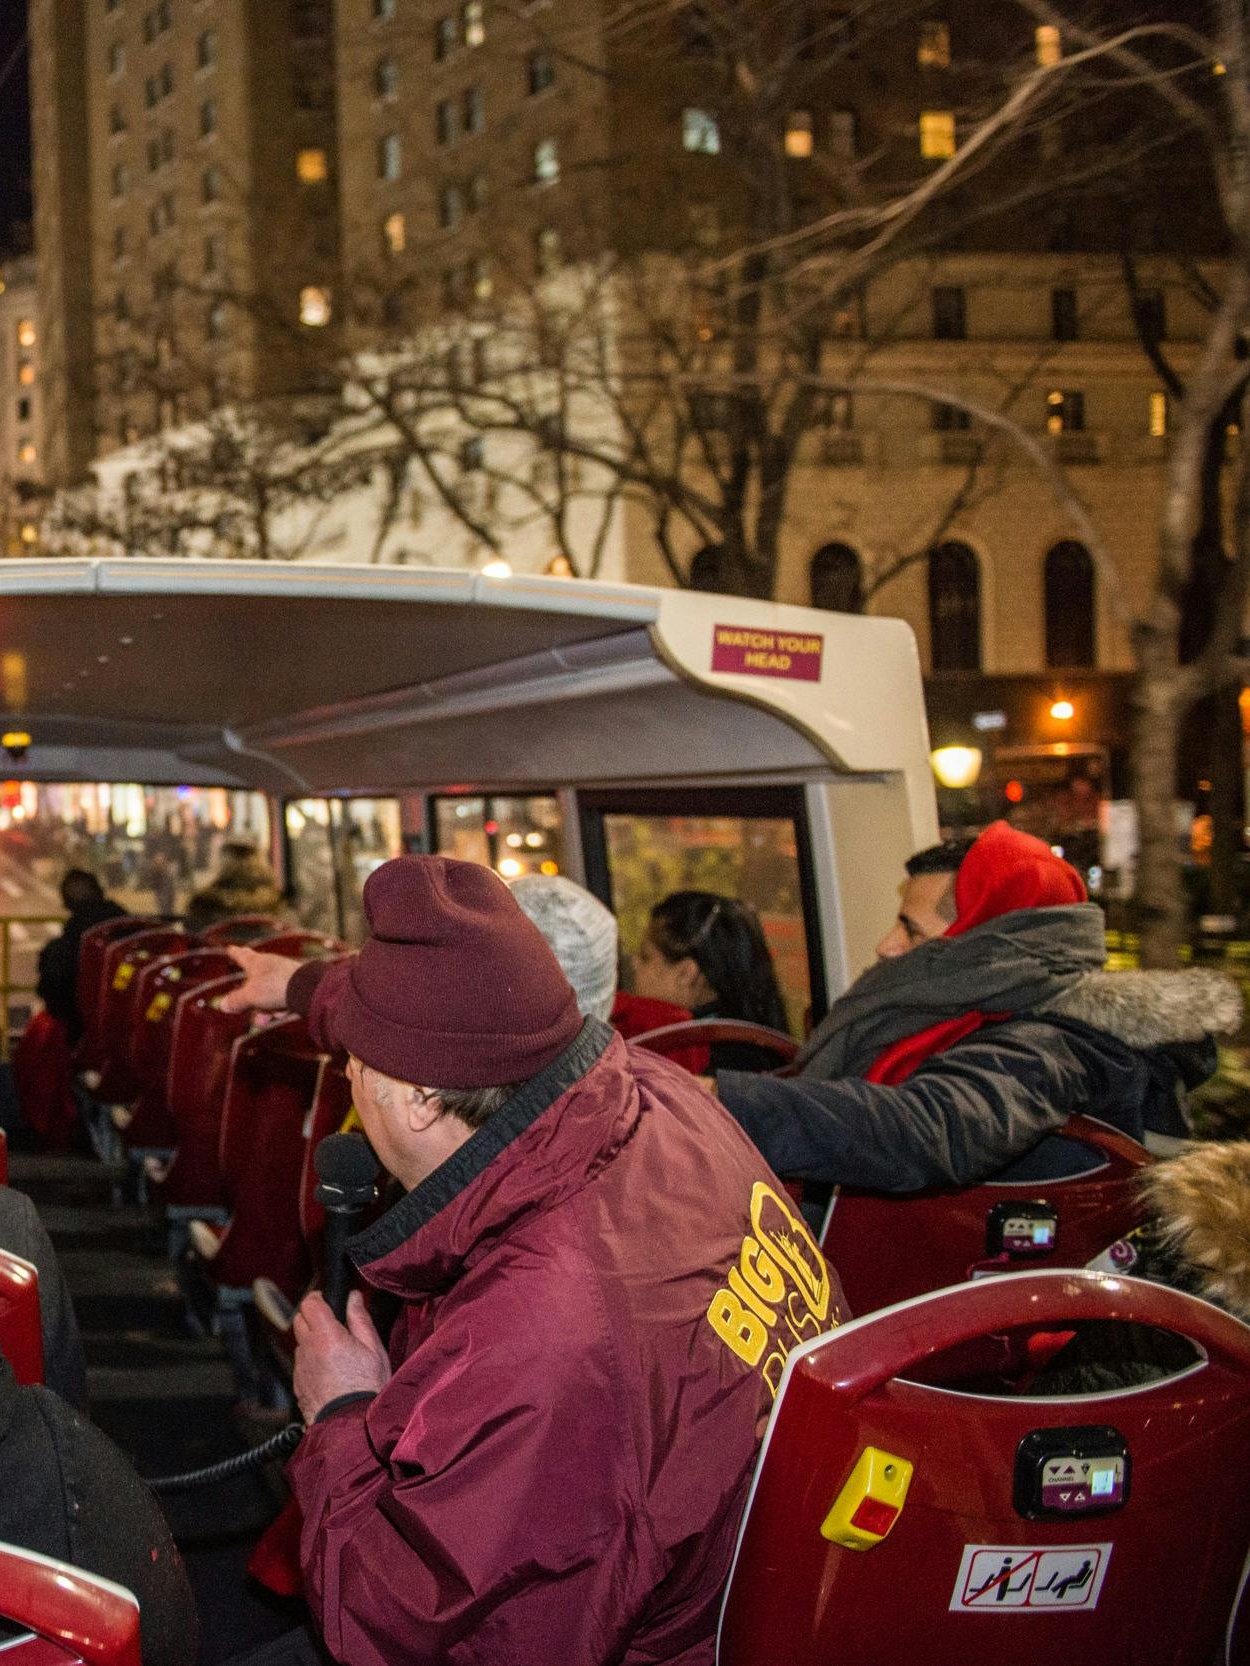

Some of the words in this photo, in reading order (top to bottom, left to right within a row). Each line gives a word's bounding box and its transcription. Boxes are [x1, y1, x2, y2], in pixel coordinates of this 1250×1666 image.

[717, 630, 774, 649] WATCH
[777, 636, 822, 654] YOUR
[744, 651, 793, 671] HEAD
[706, 1235, 786, 1367] BIG
